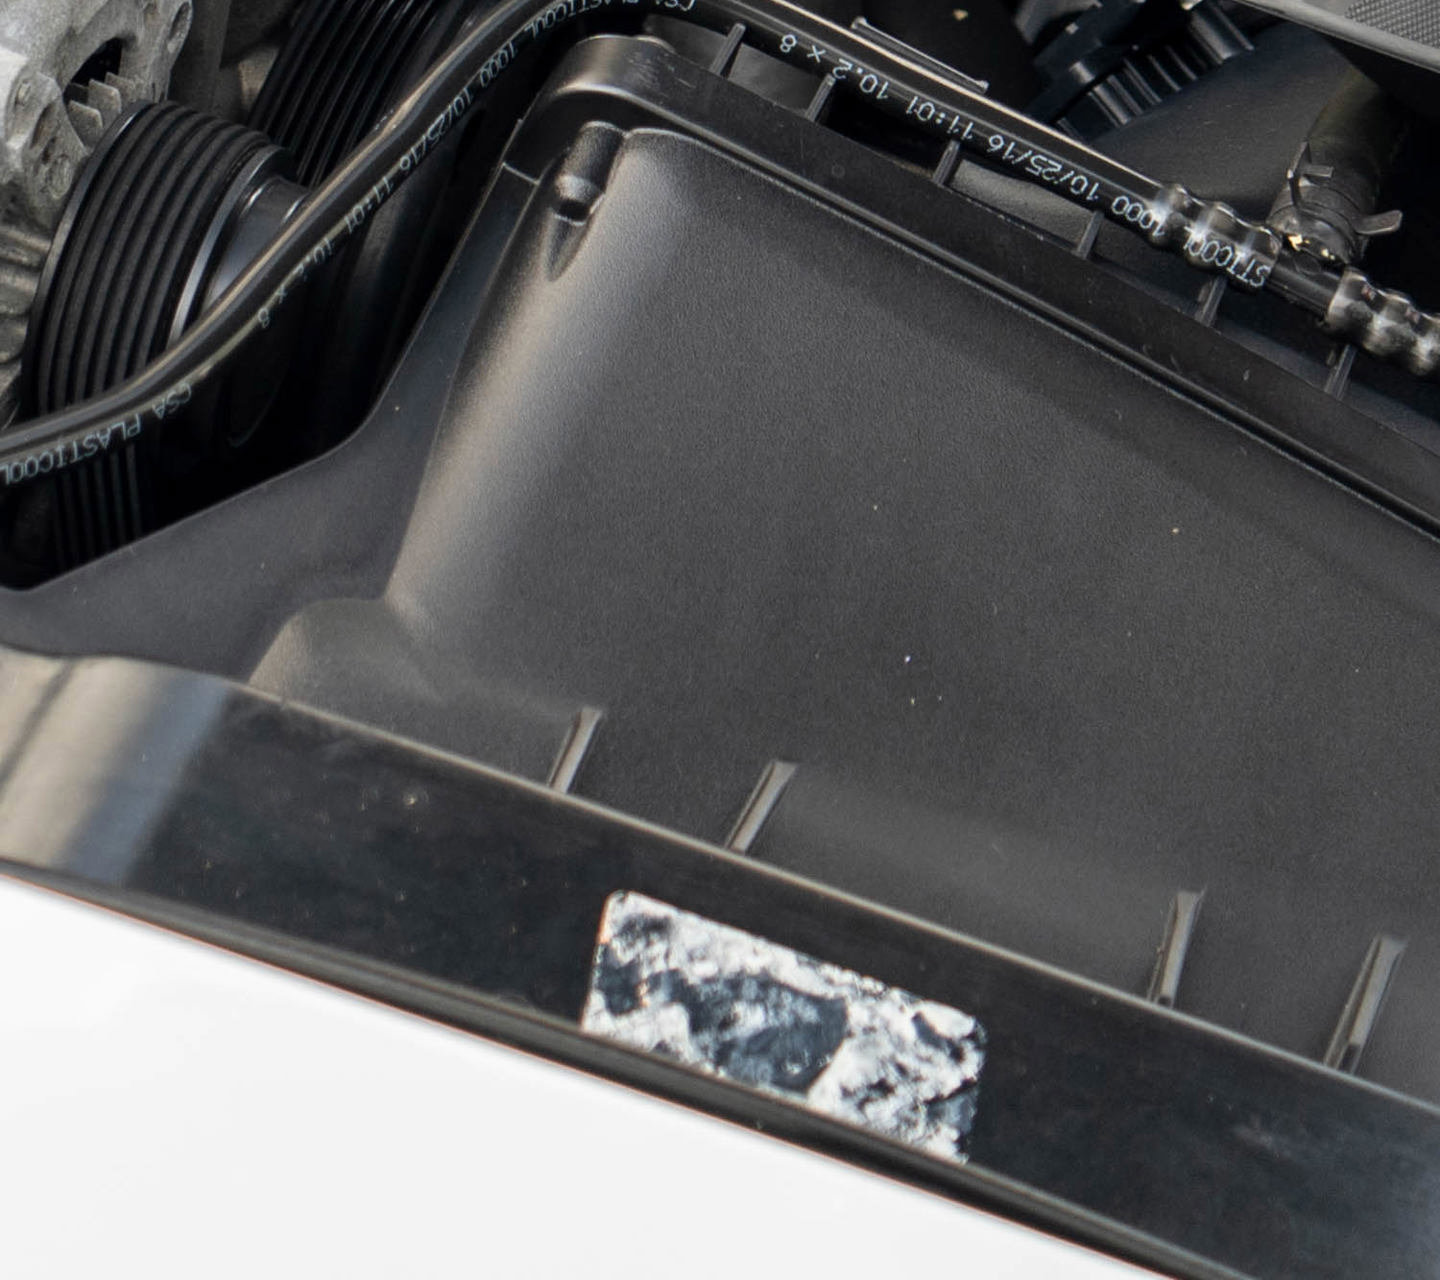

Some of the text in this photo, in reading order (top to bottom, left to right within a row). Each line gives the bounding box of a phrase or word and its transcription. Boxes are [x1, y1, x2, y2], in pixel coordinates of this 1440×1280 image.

[479, 39, 518, 88] 1000
[780, 34, 797, 53] 8
[832, 57, 889, 100] 10.2
[906, 95, 974, 140] 11:01
[987, 133, 1100, 202] 10/25/16
[344, 175, 394, 235] 11:01
[1111, 194, 1166, 239] 1000
[151, 381, 192, 420] CSA
